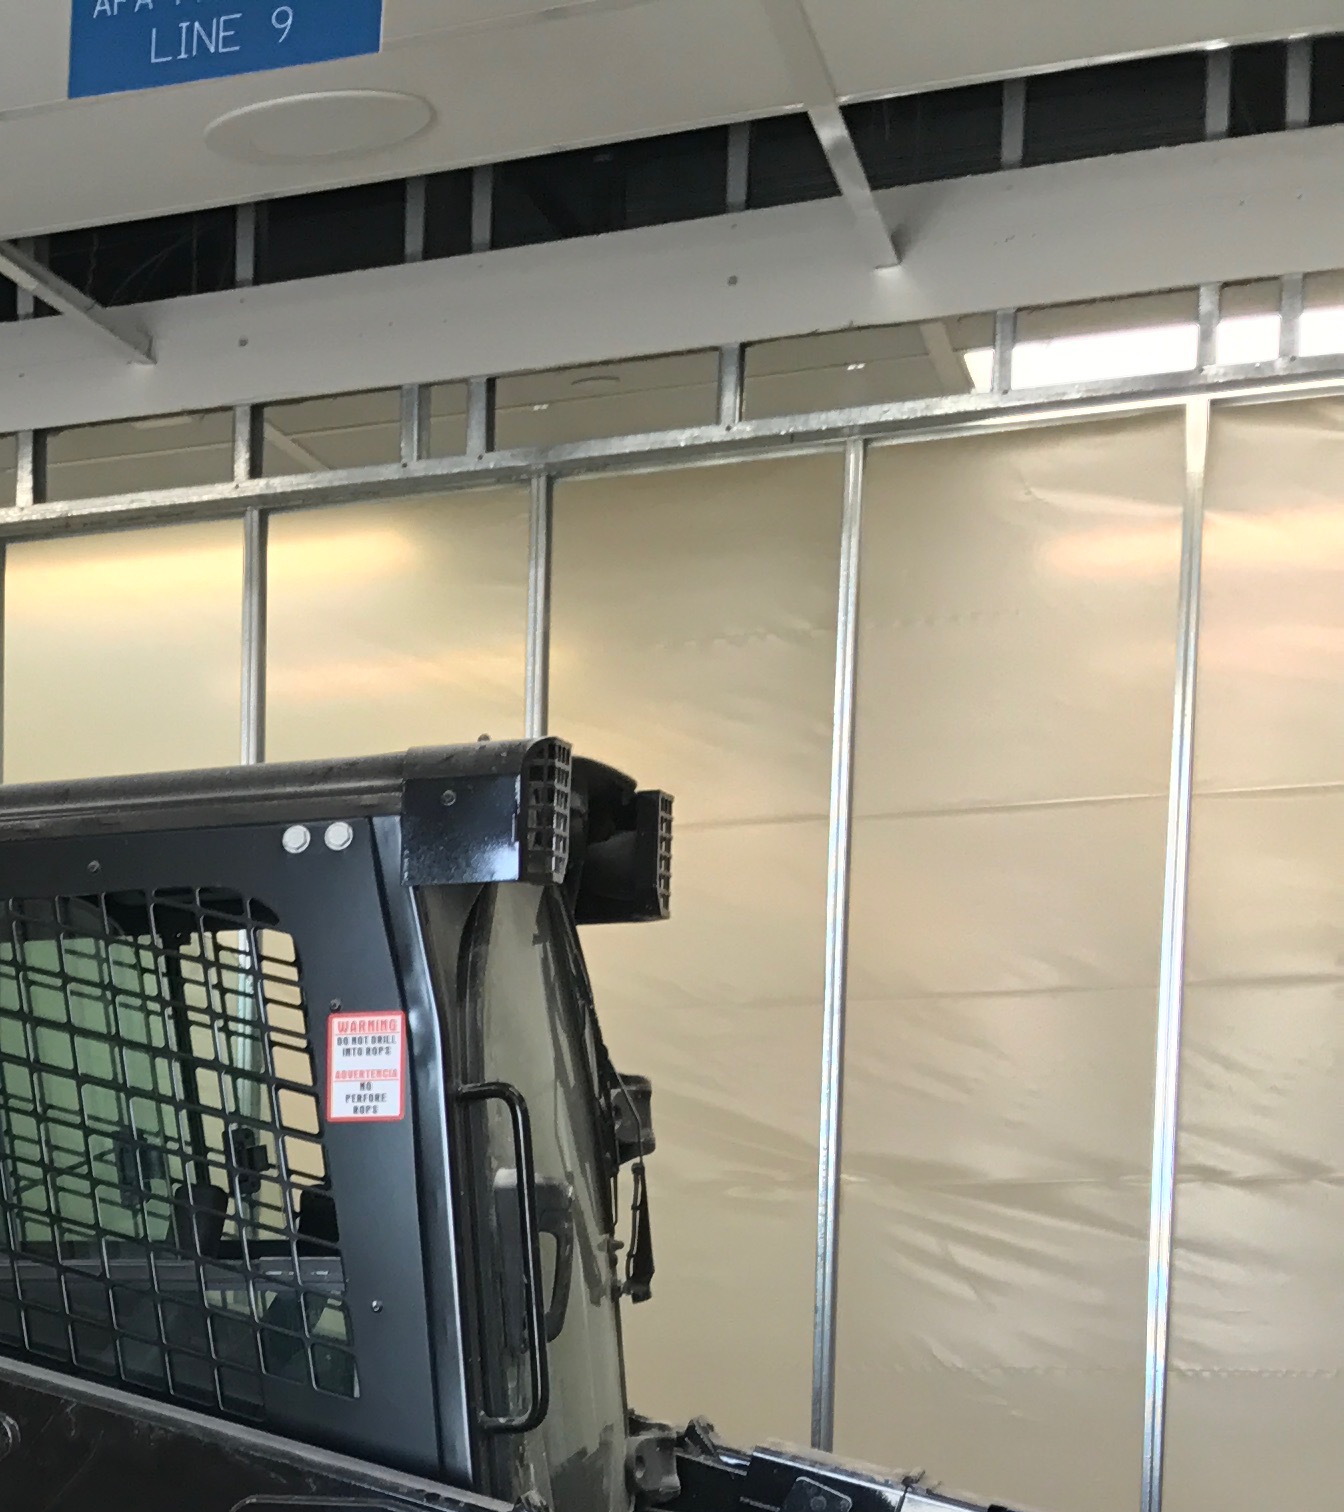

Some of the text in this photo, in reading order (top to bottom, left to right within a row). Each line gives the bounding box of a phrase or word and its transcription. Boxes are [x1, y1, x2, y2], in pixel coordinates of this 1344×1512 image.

[150, 6, 294, 64] LINE 9
[337, 1019, 397, 1033] WARNING
[336, 1035, 397, 1046] DO NOT DRILL
[342, 1046, 392, 1057] INTO ROPS
[335, 1069, 398, 1079] ADVERTENCIA
[359, 1082, 372, 1091] NO
[345, 1093, 387, 1103] PERFORE
[353, 1105, 379, 1114] ROPS
